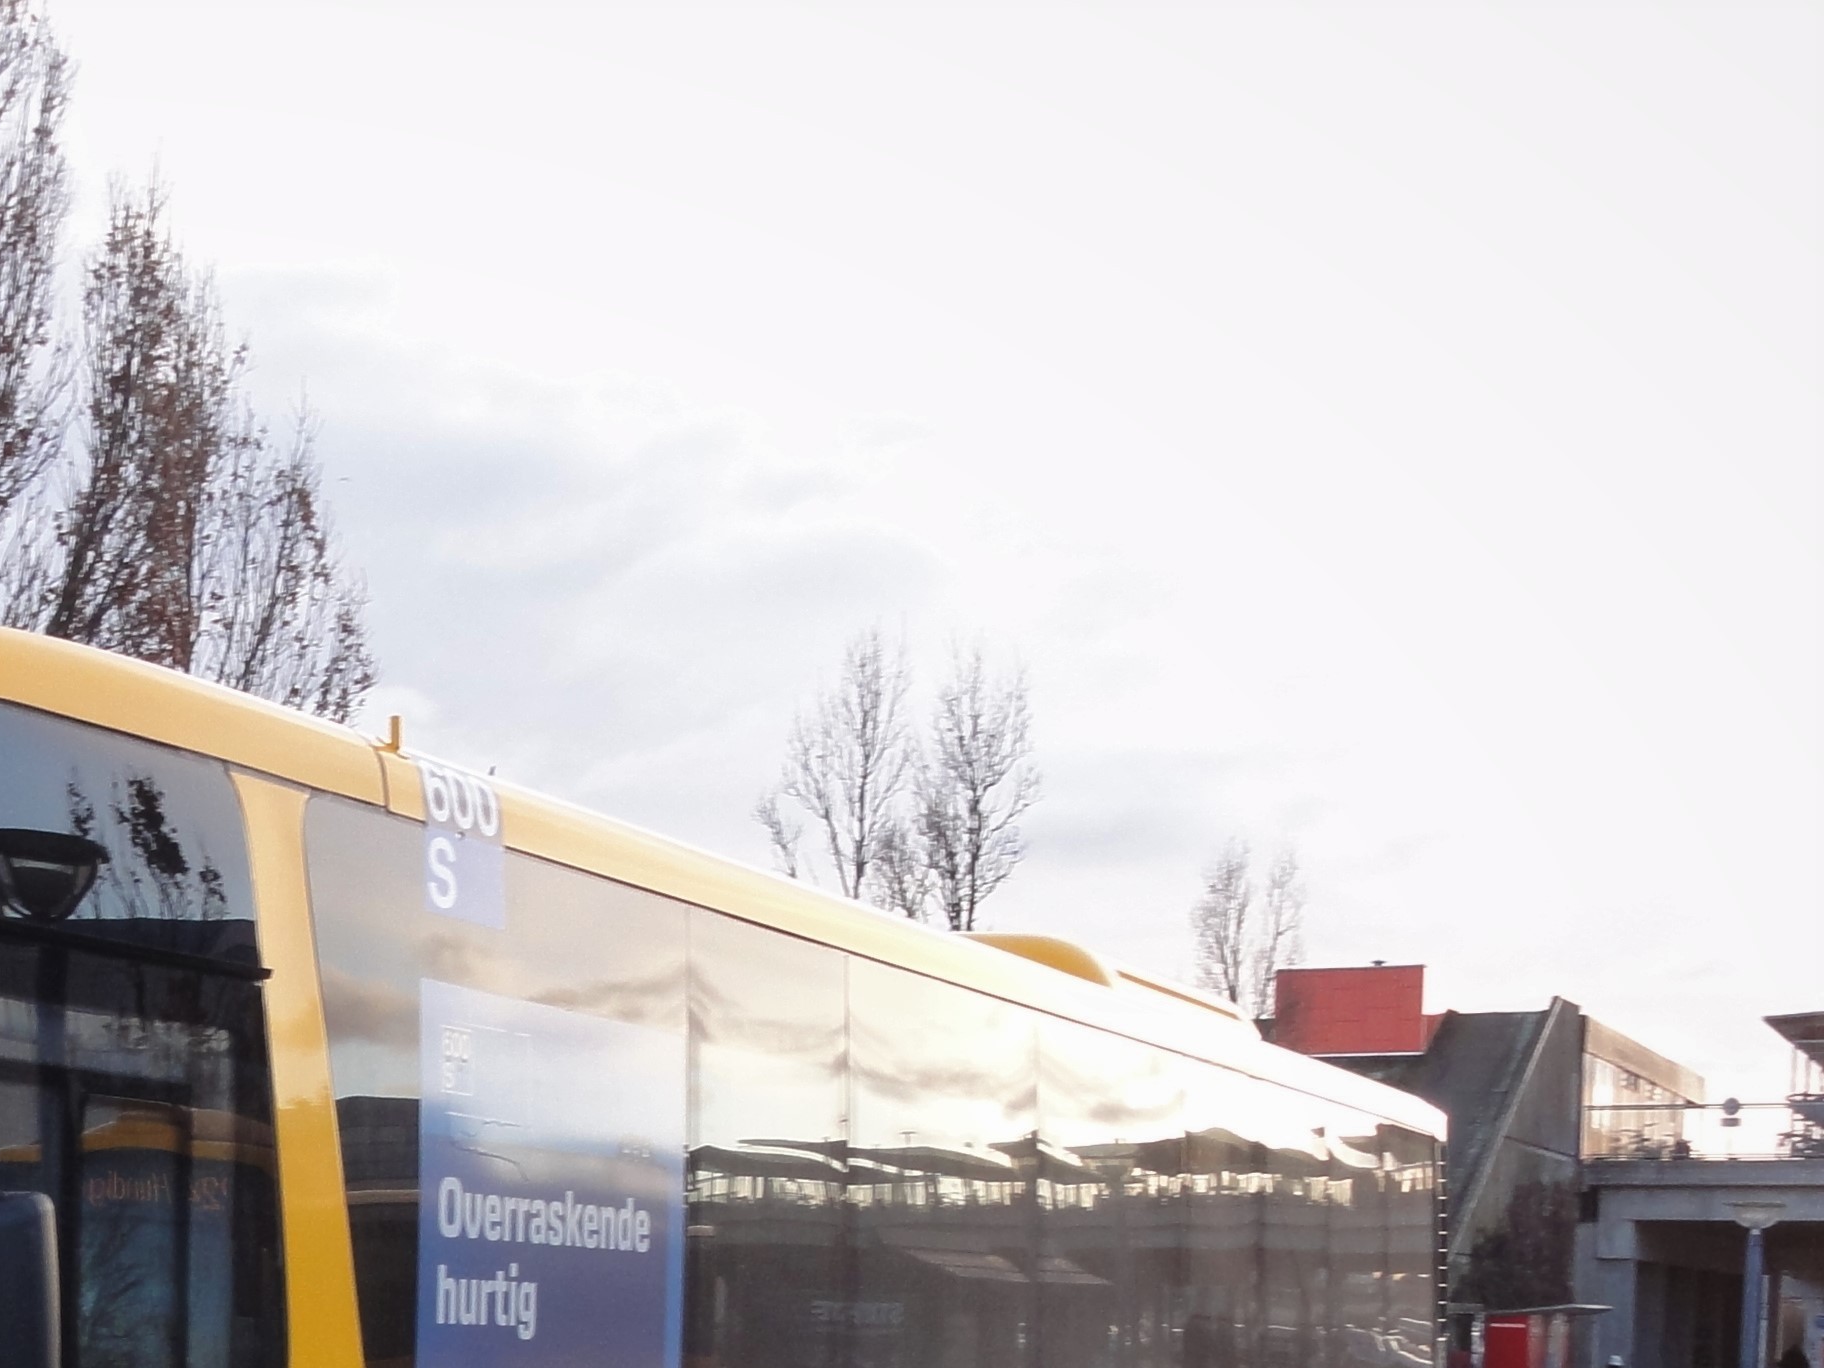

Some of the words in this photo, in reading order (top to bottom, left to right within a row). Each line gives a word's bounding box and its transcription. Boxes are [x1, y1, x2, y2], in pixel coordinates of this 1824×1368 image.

[418, 760, 499, 837] 600
[427, 836, 458, 909] S
[438, 1176, 652, 1253] Overraskende
[436, 1262, 538, 1341] hurtig
